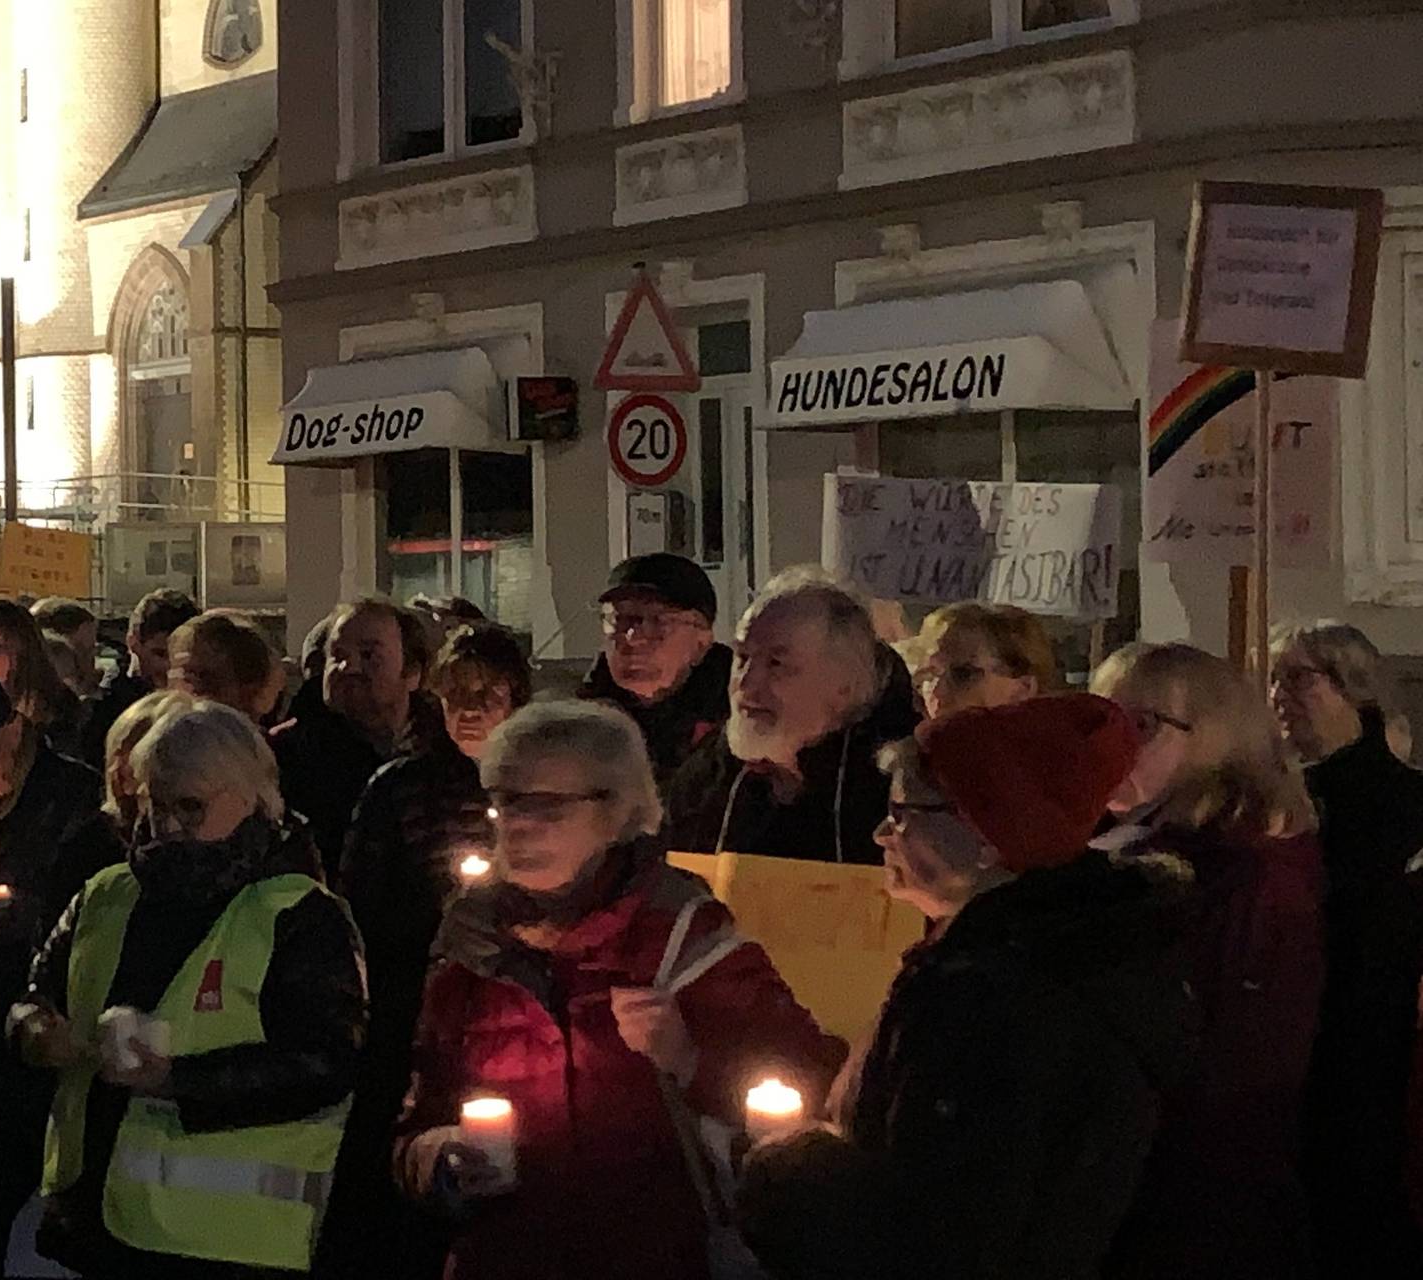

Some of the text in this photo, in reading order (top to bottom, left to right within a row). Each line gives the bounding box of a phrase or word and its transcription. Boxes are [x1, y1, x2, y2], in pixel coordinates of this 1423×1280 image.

[777, 353, 1006, 413] HUNDESALON
[285, 403, 424, 451] Dog-shop
[626, 418, 670, 460] 20
[1017, 486, 1063, 515] DES
